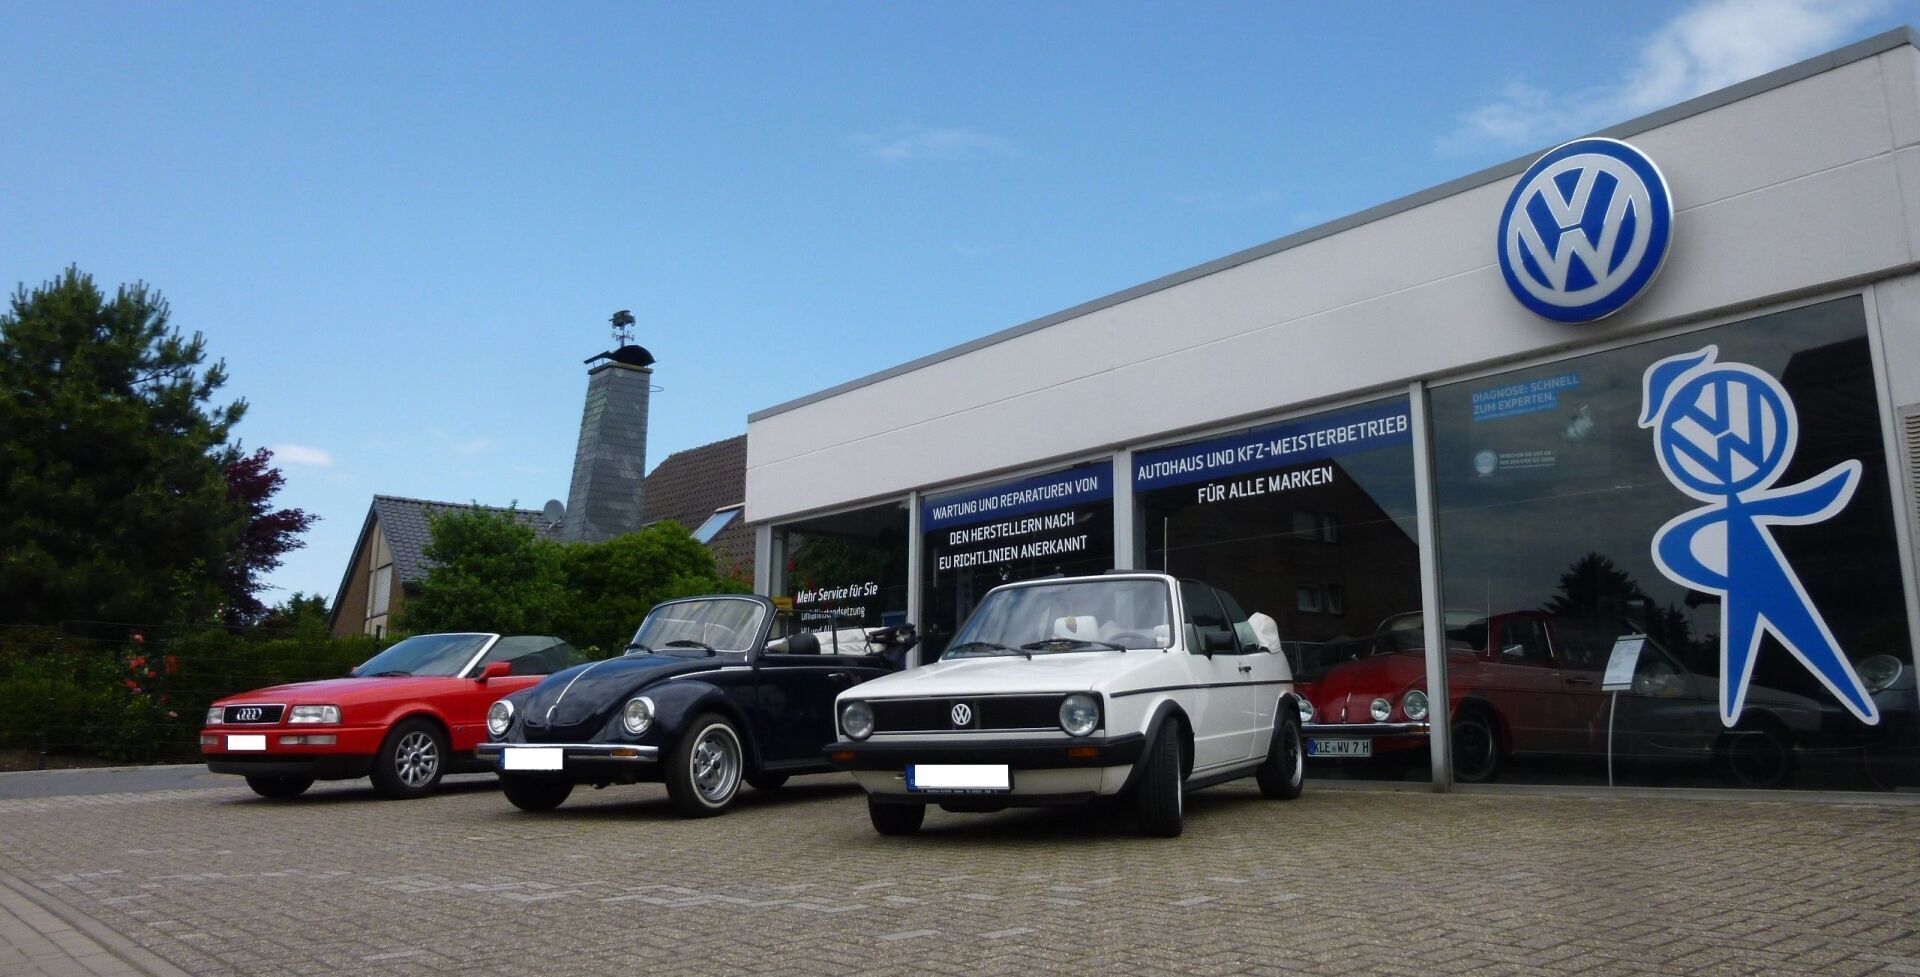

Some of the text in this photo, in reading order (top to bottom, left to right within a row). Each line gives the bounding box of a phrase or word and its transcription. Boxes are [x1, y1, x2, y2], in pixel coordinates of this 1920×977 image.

[1472, 374, 1579, 404] DIAGNOSE: SCHNELL
[1473, 402, 1497, 415] ZUM
[1498, 391, 1556, 411] EXPERTEN.
[1138, 414, 1408, 481] AUTOHAUS UND KFZ-MEISTERBETRIEB
[932, 476, 1098, 521] WARTUNG UND REPARATUREN VON
[1198, 465, 1333, 504] FÜR ALLE MARKEN
[949, 511, 1075, 546] DEN HERSTELLERN NACH
[939, 534, 1088, 570] EU RICHTLINIEN ANERKANNT
[797, 581, 878, 604] Mehr Service für Sie
[1337, 741, 1349, 753] WV
[1353, 741, 1359, 753] 7
[1363, 741, 1369, 753] H
